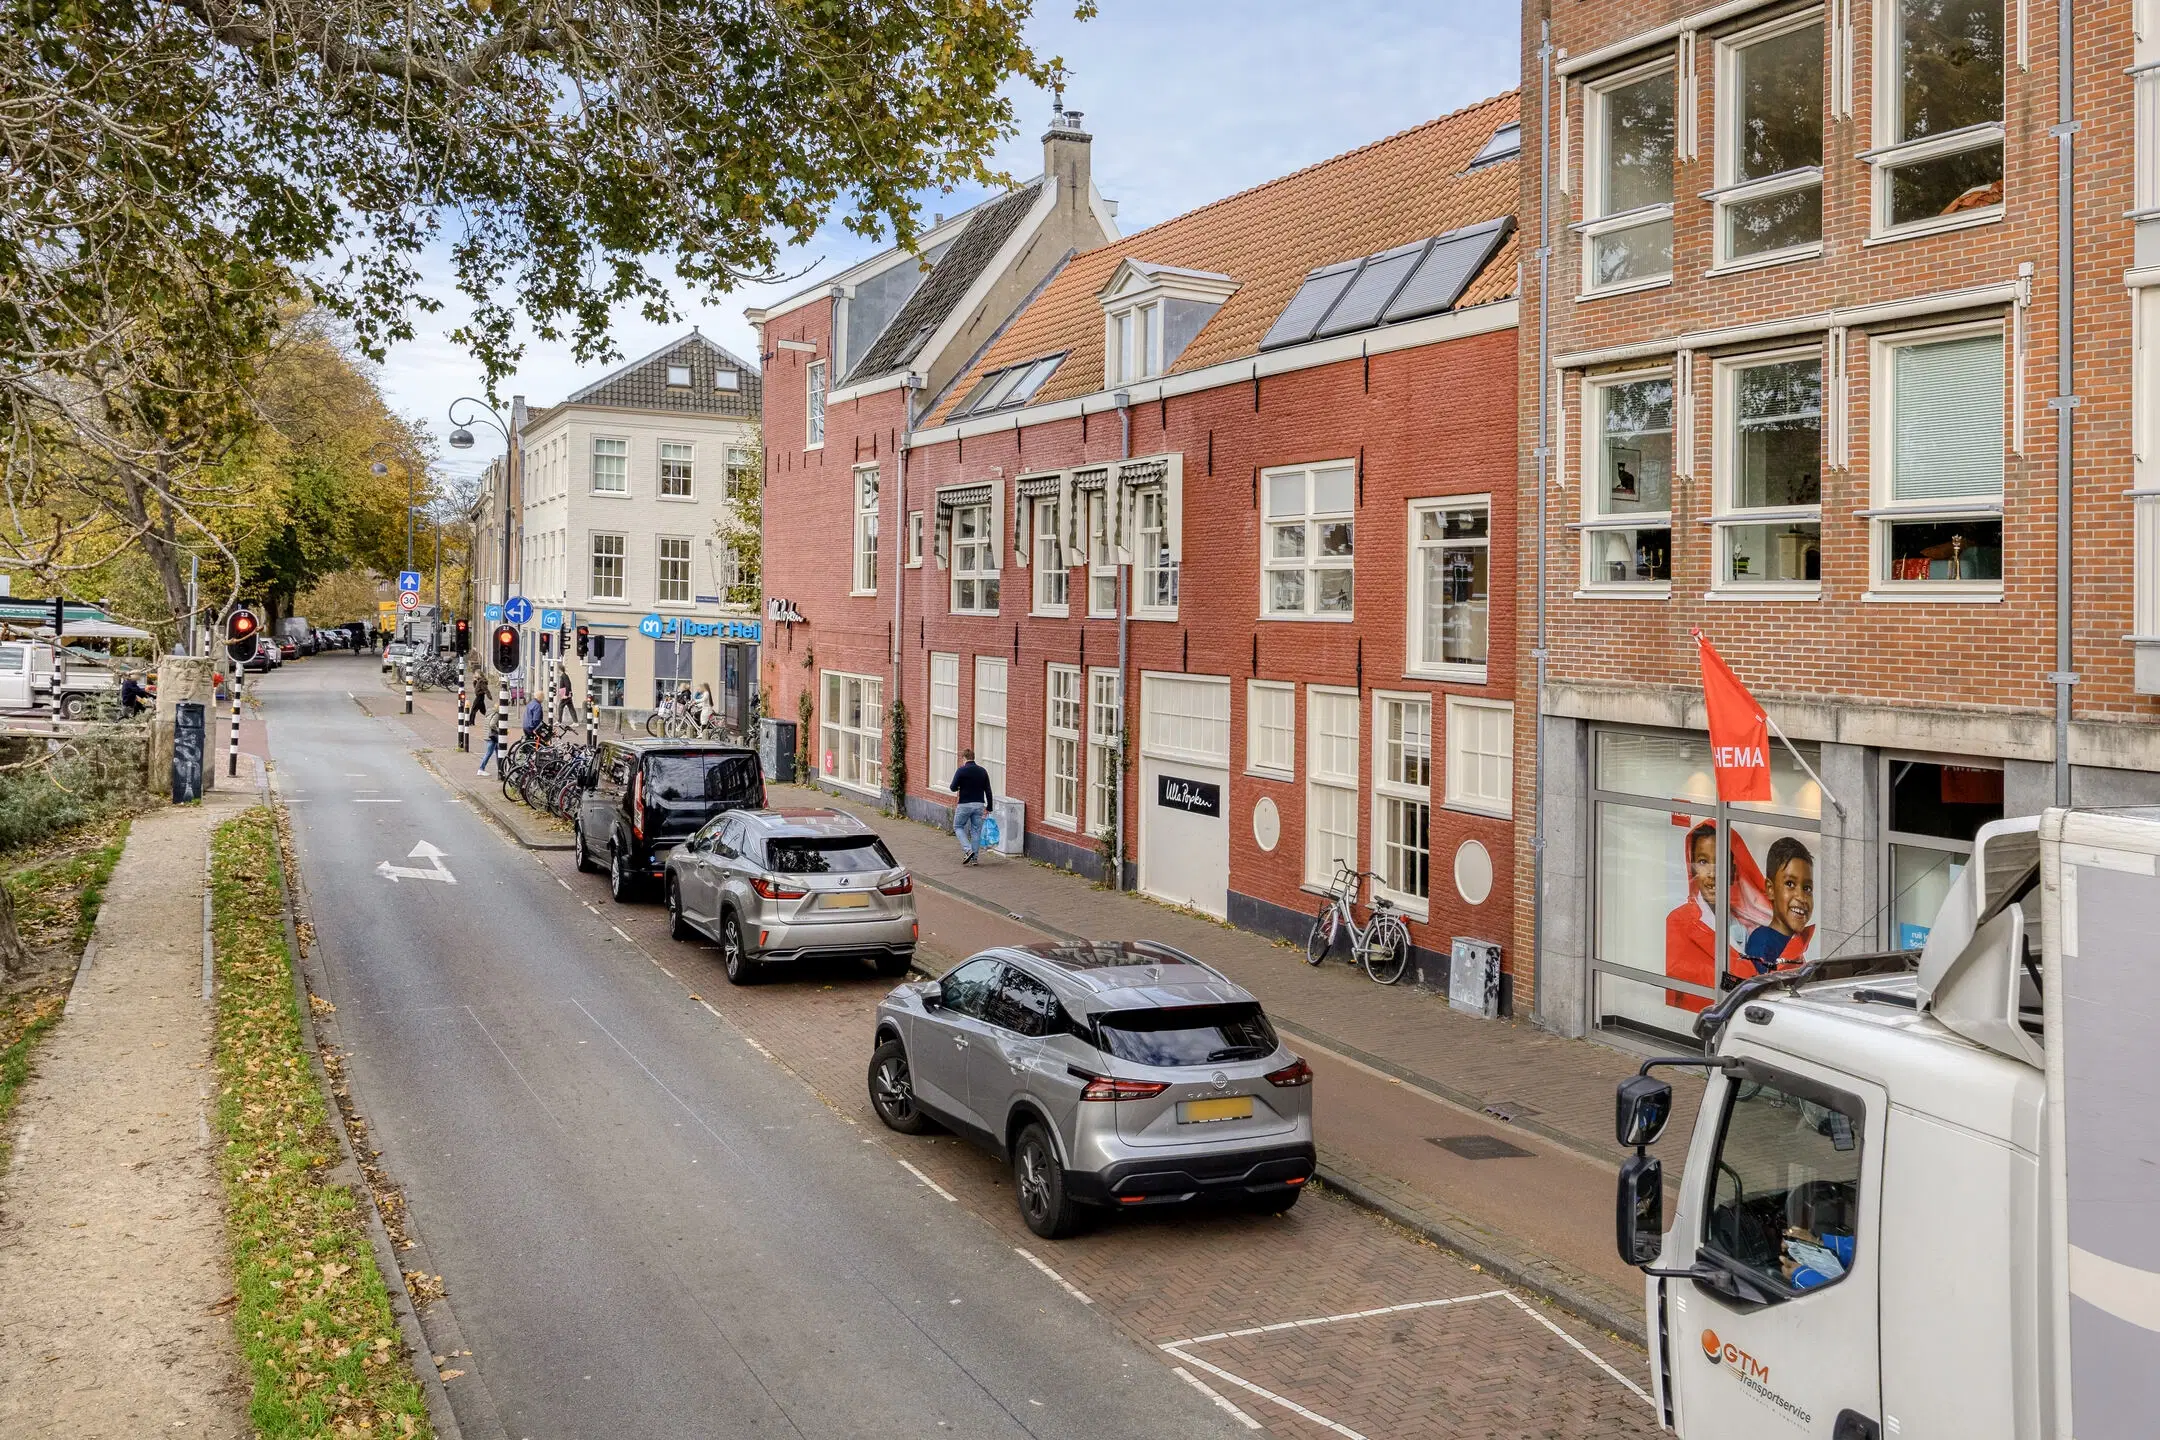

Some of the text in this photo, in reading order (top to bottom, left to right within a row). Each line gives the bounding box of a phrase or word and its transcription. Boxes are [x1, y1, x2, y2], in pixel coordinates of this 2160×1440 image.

[404, 596, 415, 605] 30
[665, 617, 724, 637] Albert
[1714, 746, 1765, 768] HEMA
[1166, 779, 1212, 810] Ulla Popken
[1723, 1342, 1769, 1384] GTM
[1740, 1370, 1811, 1423] Transportservice
